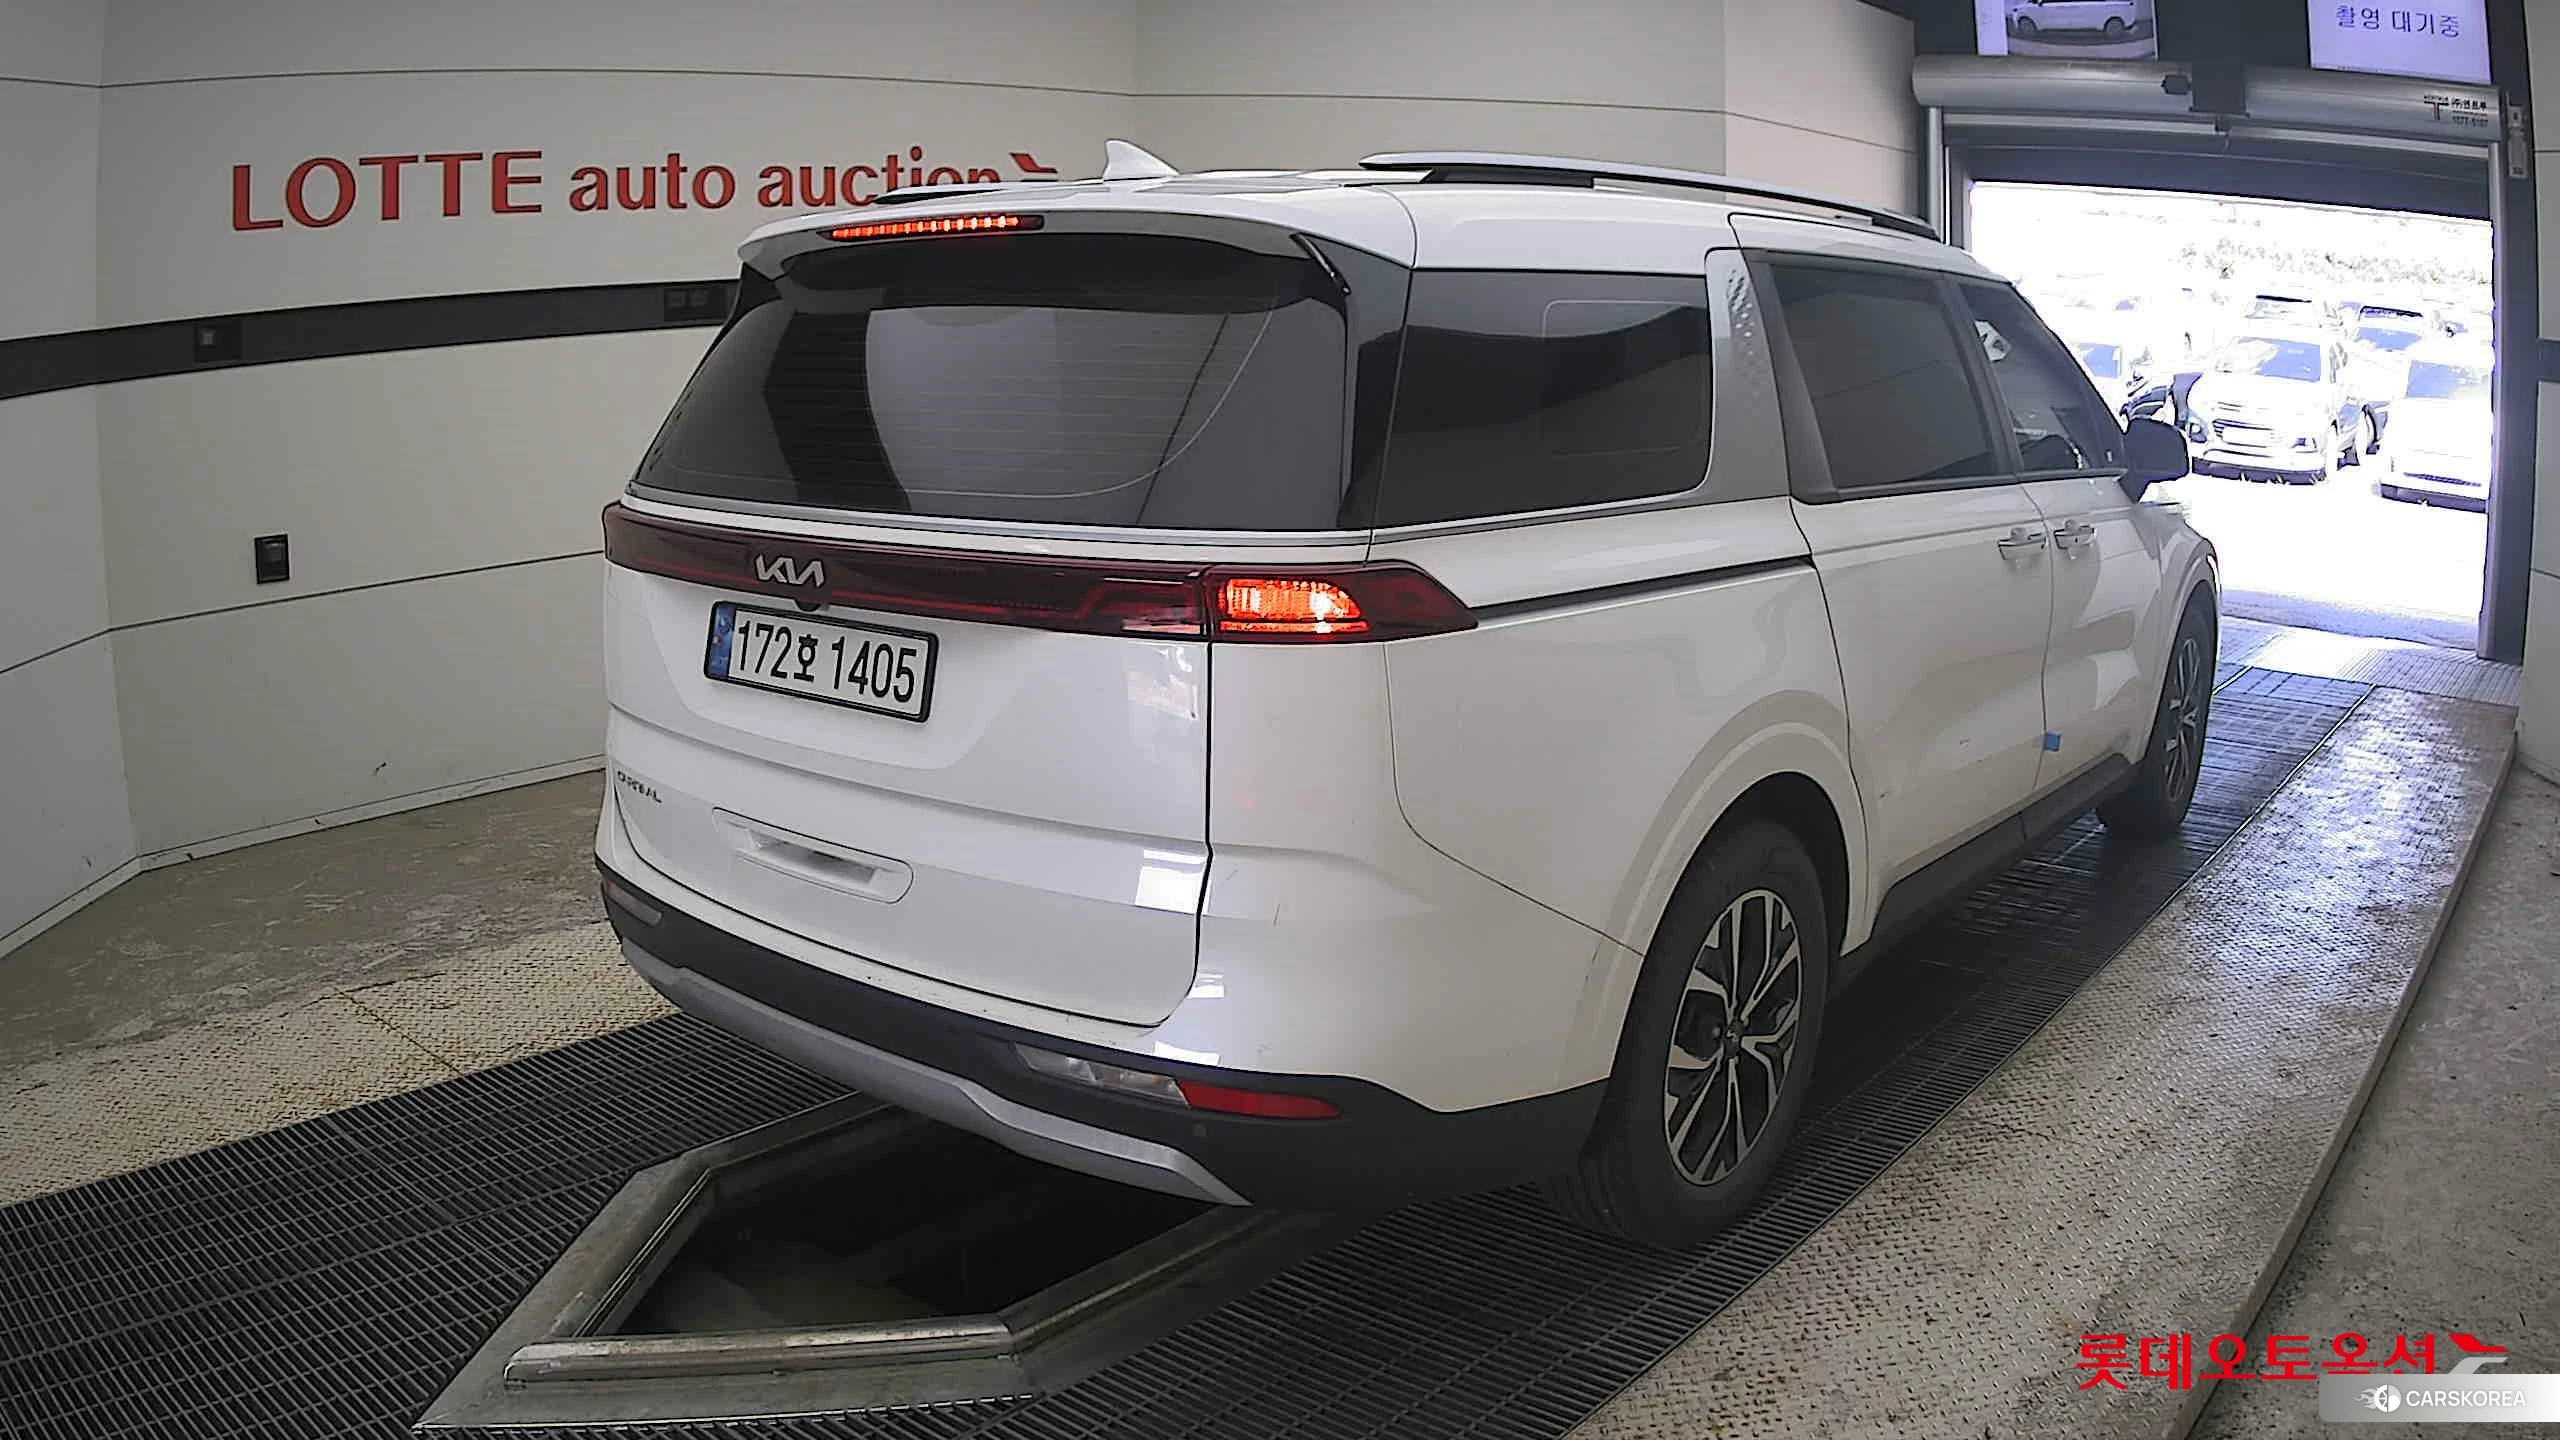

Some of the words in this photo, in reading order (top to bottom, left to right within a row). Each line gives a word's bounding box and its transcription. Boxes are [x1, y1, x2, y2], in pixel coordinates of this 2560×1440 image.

[2336, 5, 2380, 30] 촬영
[2391, 10, 2459, 38] 대기중
[232, 150, 543, 231] LOTTE
[569, 152, 736, 211] auto
[754, 553, 826, 587] KIA
[738, 619, 819, 683] 172호
[831, 635, 918, 703] 1405
